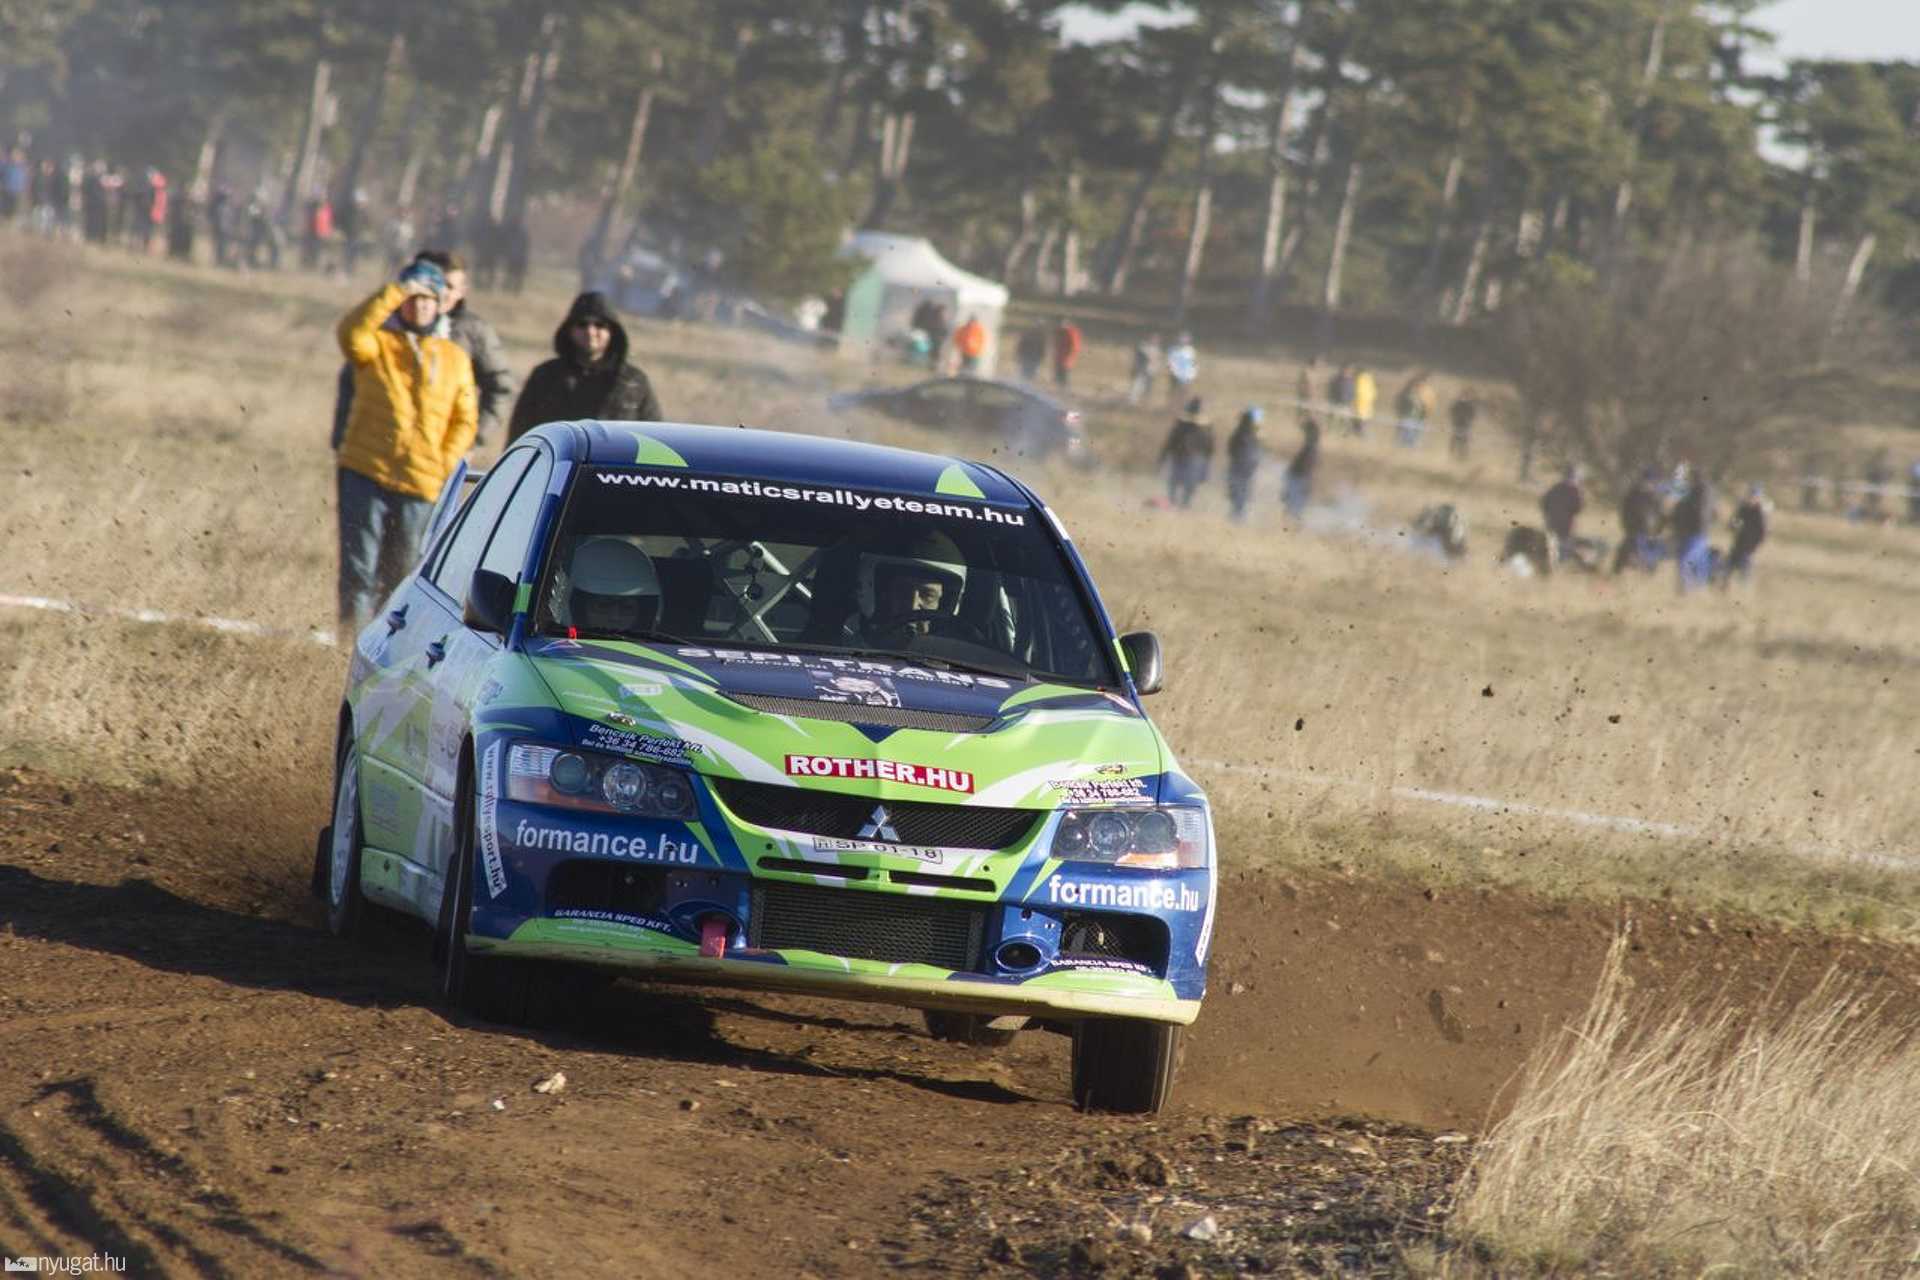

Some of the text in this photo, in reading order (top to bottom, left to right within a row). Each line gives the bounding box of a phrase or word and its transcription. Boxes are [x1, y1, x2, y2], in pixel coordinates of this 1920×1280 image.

[597, 473, 1025, 526] www.maticsrallyeteam.hu
[677, 648, 802, 663] SEPI
[790, 755, 970, 791] ROTHER.HU
[516, 819, 699, 864] formance.hu
[1049, 875, 1199, 911] formance.hu
